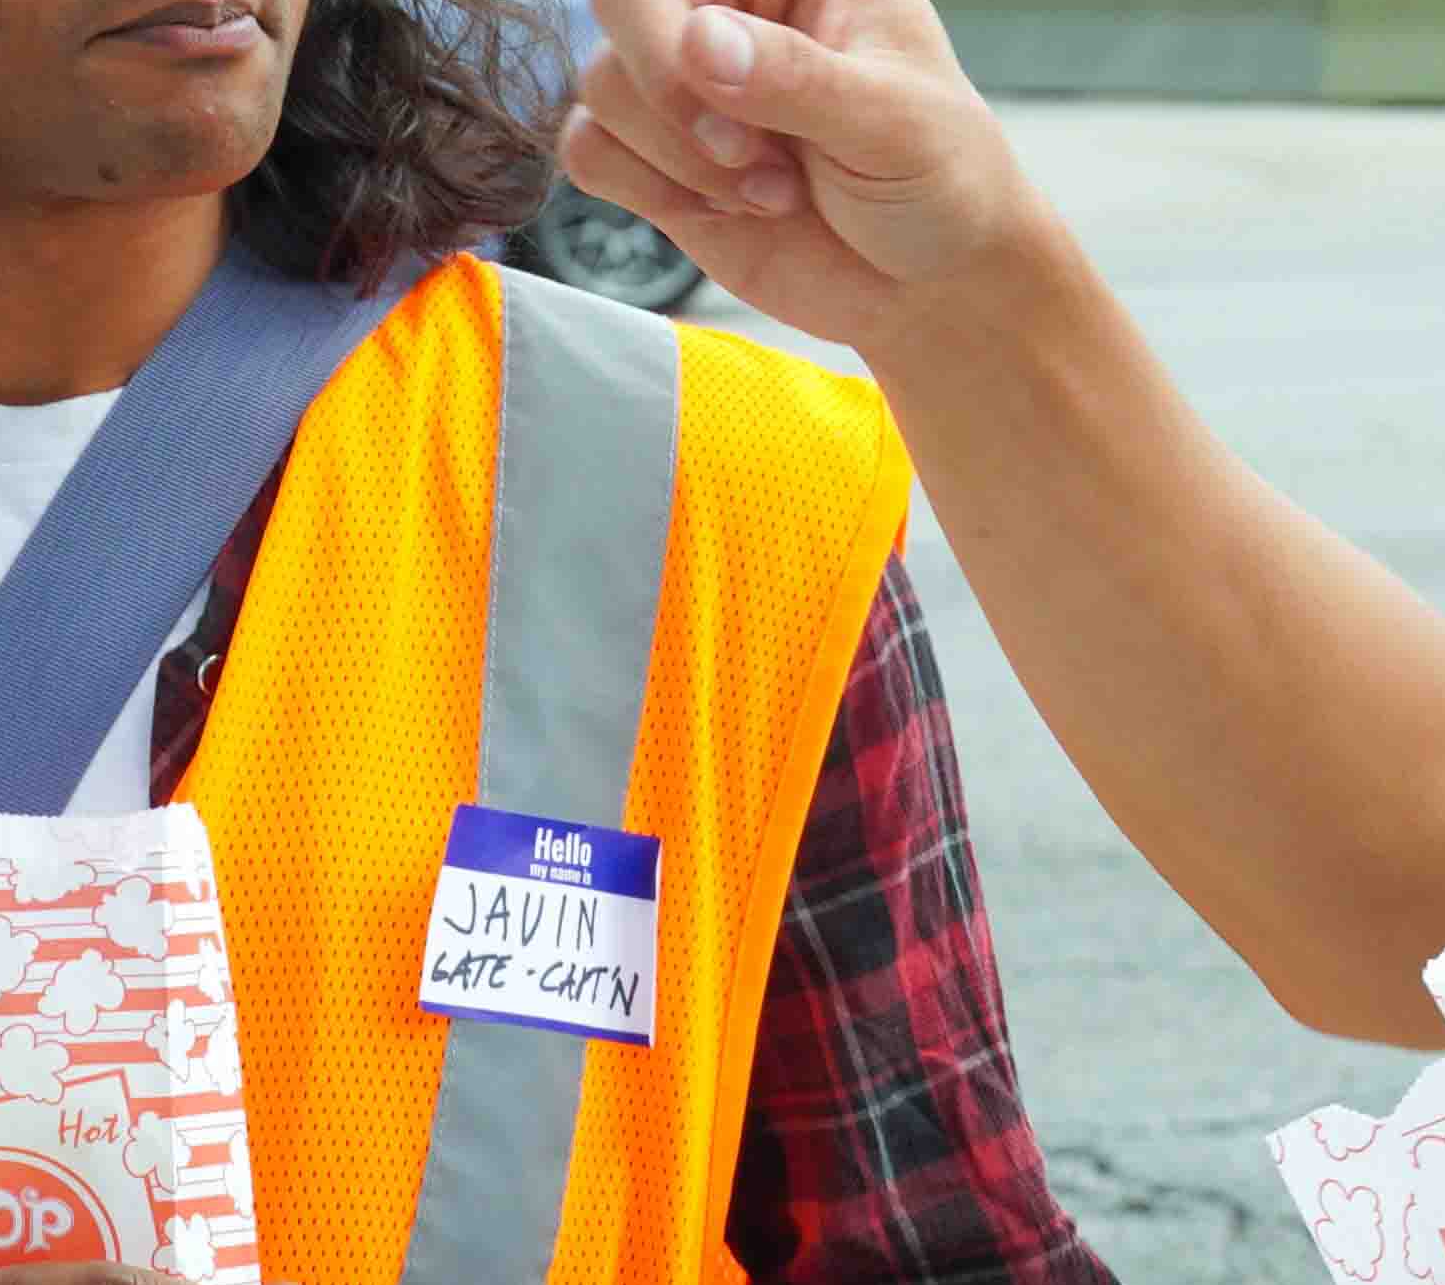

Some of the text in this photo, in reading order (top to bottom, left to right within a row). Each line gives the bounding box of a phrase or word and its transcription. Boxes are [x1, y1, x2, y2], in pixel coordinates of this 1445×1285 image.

[534, 826, 592, 866] Hello
[529, 863, 548, 880] my
[57, 1109, 119, 1149] Hot
